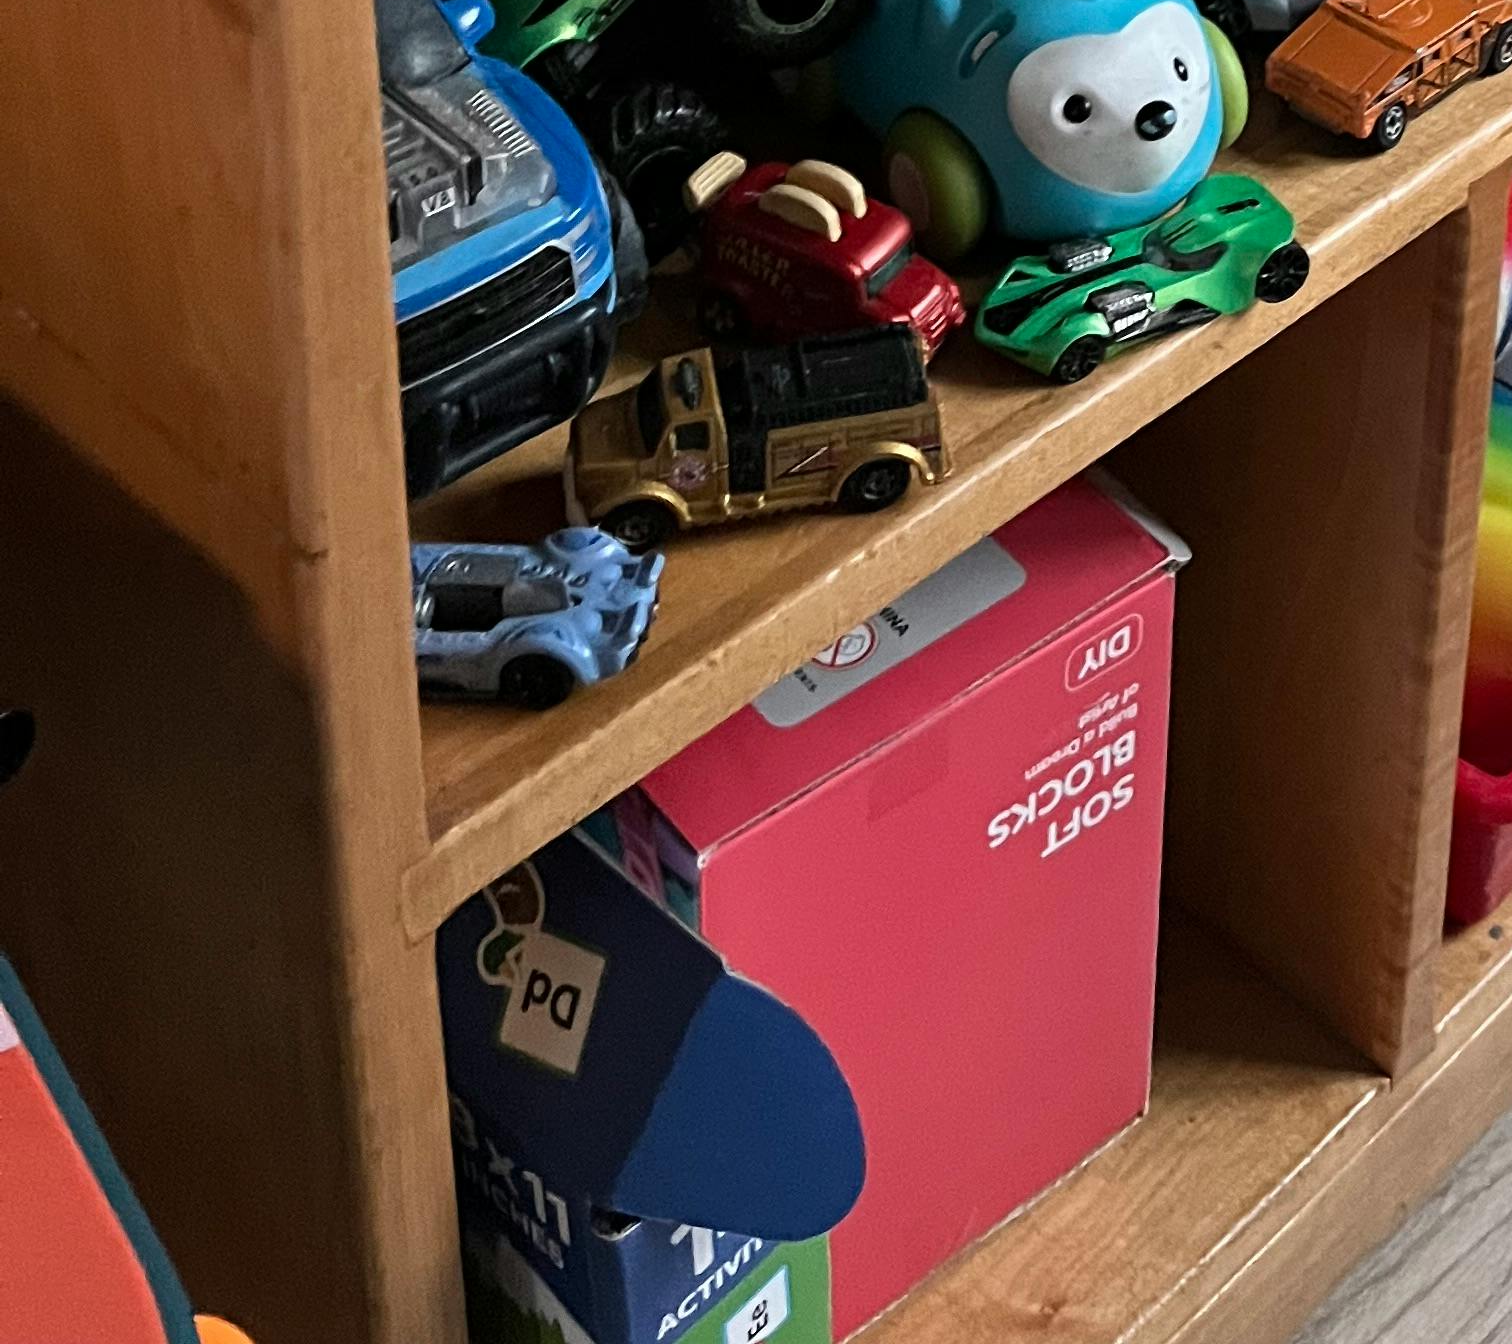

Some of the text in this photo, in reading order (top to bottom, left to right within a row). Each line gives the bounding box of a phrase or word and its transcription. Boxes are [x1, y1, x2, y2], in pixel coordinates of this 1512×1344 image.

[1078, 625, 1131, 680] DIY
[987, 729, 1137, 849] BLOCKS
[1024, 737, 1082, 781] Dream
[1040, 773, 1136, 859] SOFT
[521, 969, 582, 1031] Dd
